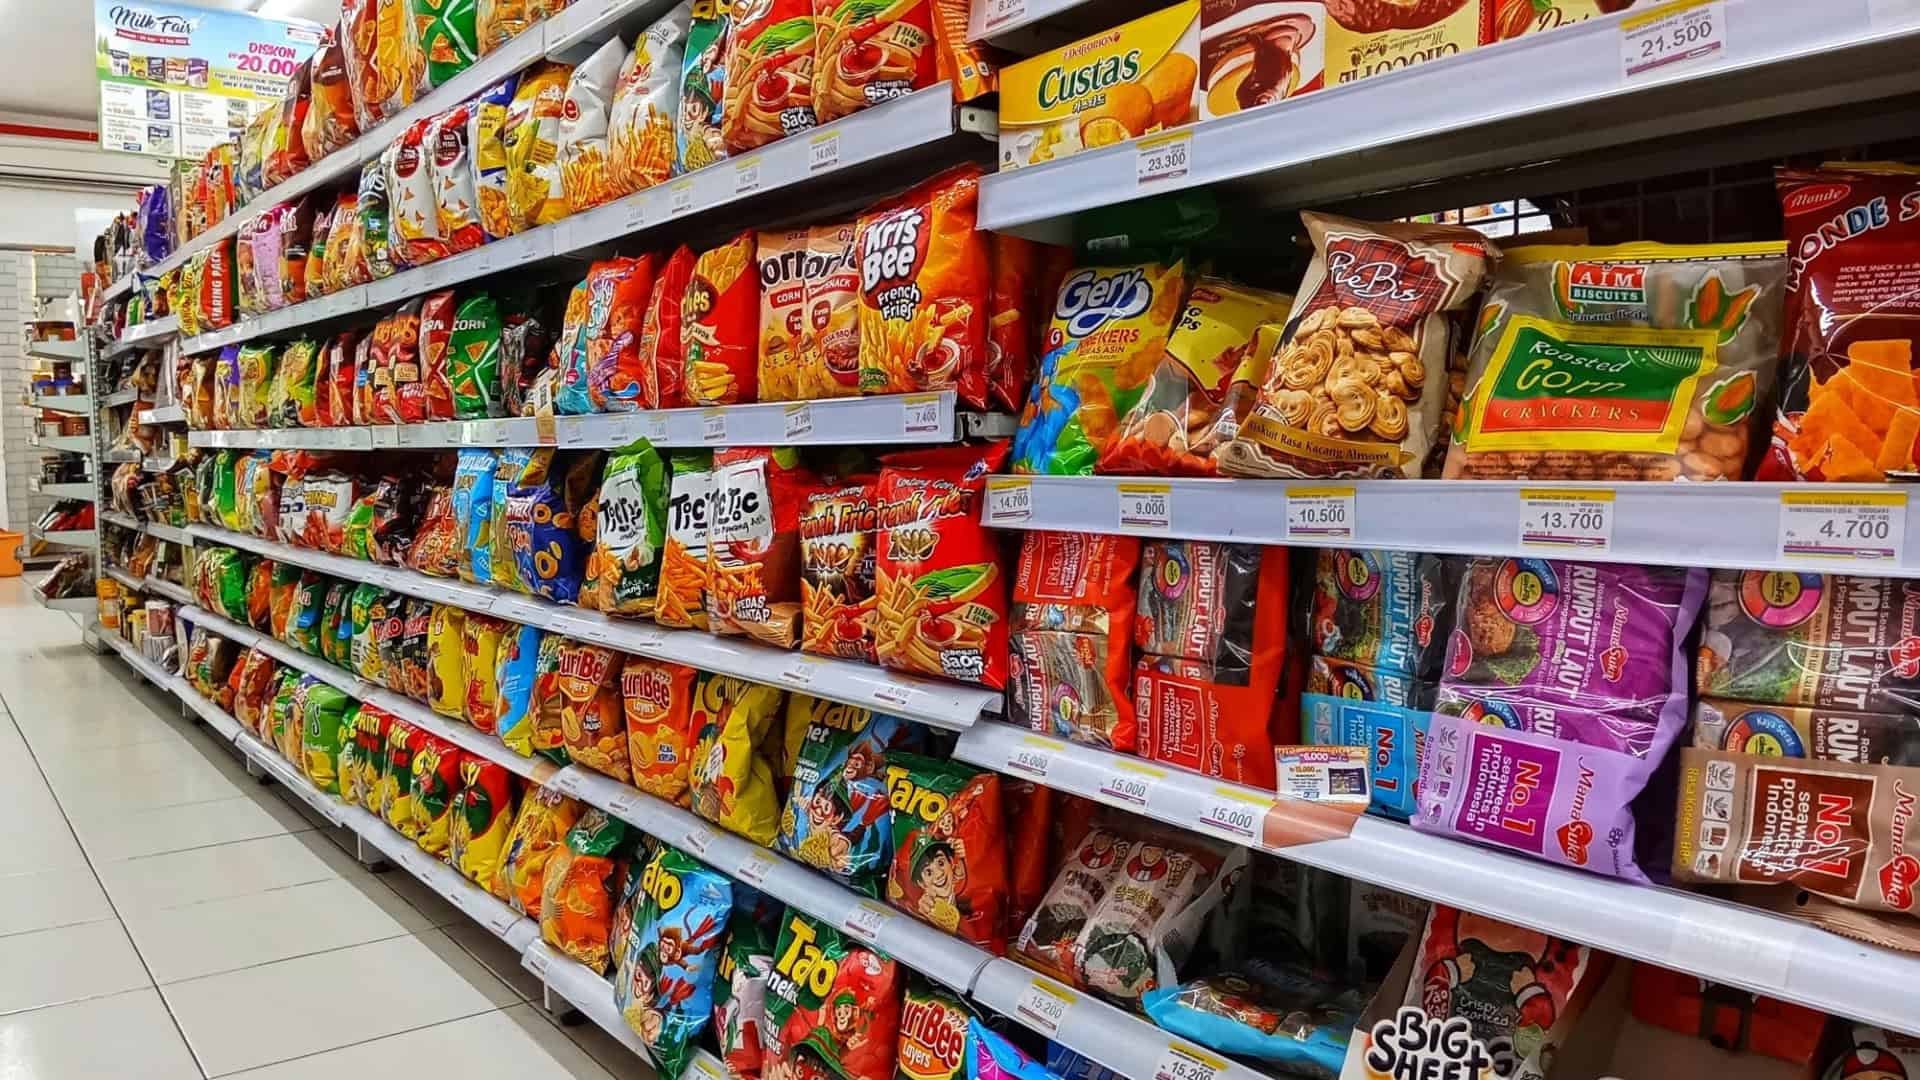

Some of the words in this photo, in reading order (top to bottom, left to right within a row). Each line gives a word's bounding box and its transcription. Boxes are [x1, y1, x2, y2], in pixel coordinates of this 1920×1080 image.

[110, 5, 155, 28] Milk
[156, 15, 193, 34] Fair
[249, 42, 296, 58] DISKON
[1640, 20, 1712, 58] 21.500
[1038, 49, 1140, 110] Custas
[1148, 151, 1186, 172] 23.300
[1790, 186, 1843, 208] Monde
[865, 208, 922, 257] Kris
[1785, 196, 1888, 292] MONDE
[864, 245, 916, 292] Bee
[1577, 271, 1636, 289] AIM
[878, 282, 920, 304] French
[1056, 267, 1154, 339] Gery
[1573, 287, 1639, 301] BISCUITS
[883, 301, 915, 321] Fries
[1528, 340, 1633, 374] Roasted
[1516, 357, 1627, 395] Corn
[914, 408, 937, 423] 7.400
[1502, 403, 1641, 422] CRACKERS
[1280, 433, 1303, 449] Rasa
[999, 495, 1029, 509] 14.700
[1135, 502, 1166, 515] 9.000
[1299, 508, 1345, 523] 10.500
[1541, 512, 1604, 530] 13.700
[1820, 520, 1889, 539] 4.700
[1196, 545, 1211, 609] RUMPUT
[737, 595, 766, 609] PEDAS
[1567, 564, 1597, 645] RUMPUT
[1190, 612, 1209, 657] LAUT
[1387, 622, 1408, 669] LAUT
[1023, 633, 1040, 670] LAUT
[1556, 648, 1587, 700] LAUT
[1833, 649, 1869, 710] LAUT
[1029, 675, 1044, 731] RUMPUT
[1815, 717, 1827, 753] Kering
[1016, 751, 1048, 770] 15.000
[886, 765, 948, 822] Taro
[1111, 778, 1146, 798] 15.000
[1466, 747, 1491, 823] Indonesia
[1481, 743, 1502, 814] products
[1488, 756, 1512, 826] seaweed
[1686, 767, 1699, 793] Rasa
[1211, 806, 1253, 829] 15.000
[1474, 815, 1490, 832] in
[1683, 797, 1697, 838] Korean
[1752, 784, 1779, 873] Indonesia
[1771, 777, 1797, 857] products
[1785, 791, 1811, 870] seaweed
[1031, 995, 1063, 1020] 15.200
[1425, 983, 1448, 1004] Tao
[1460, 994, 1499, 1015] Crispy
[1399, 1009, 1471, 1060] BIG
[902, 1040, 932, 1068] Layers
